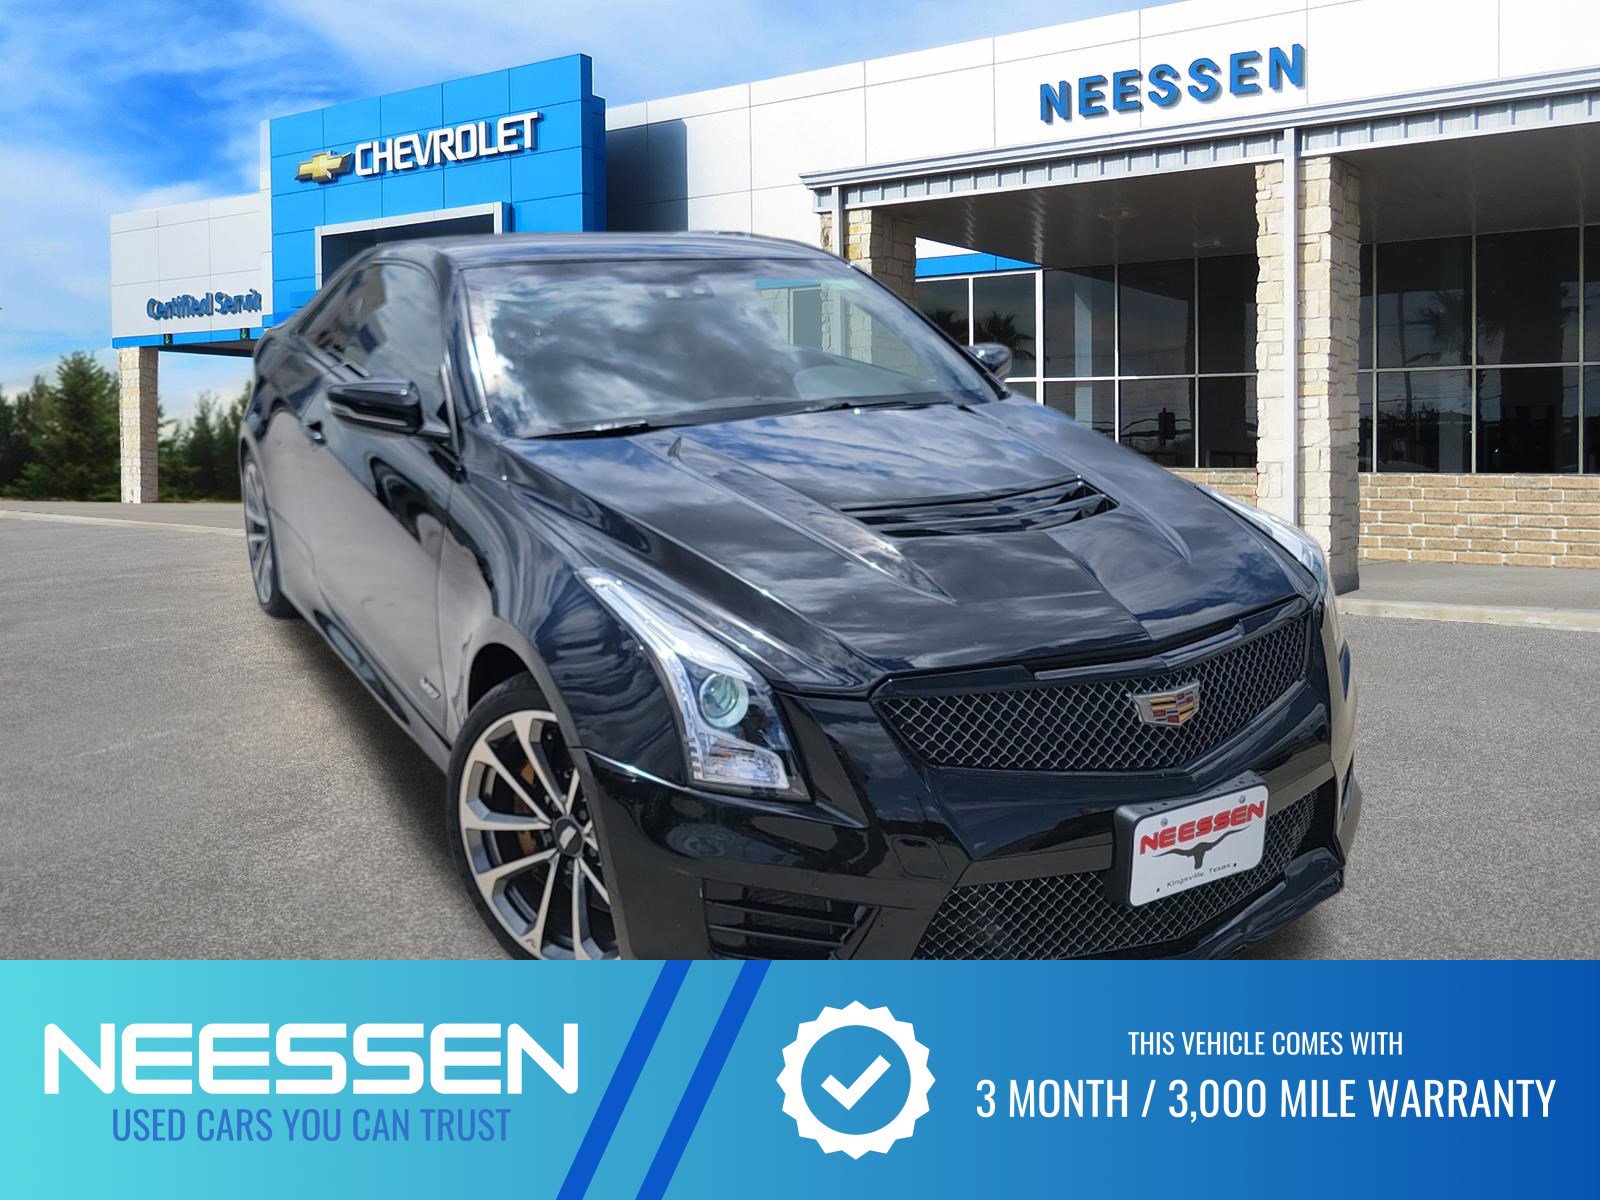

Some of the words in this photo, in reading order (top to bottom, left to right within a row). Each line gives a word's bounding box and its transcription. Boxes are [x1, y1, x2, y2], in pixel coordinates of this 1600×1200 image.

[1040, 44, 1306, 124] NEESSEN
[355, 112, 544, 177] CHEVROLET
[147, 292, 214, 320] Certified
[1140, 800, 1265, 855] NEESSEN
